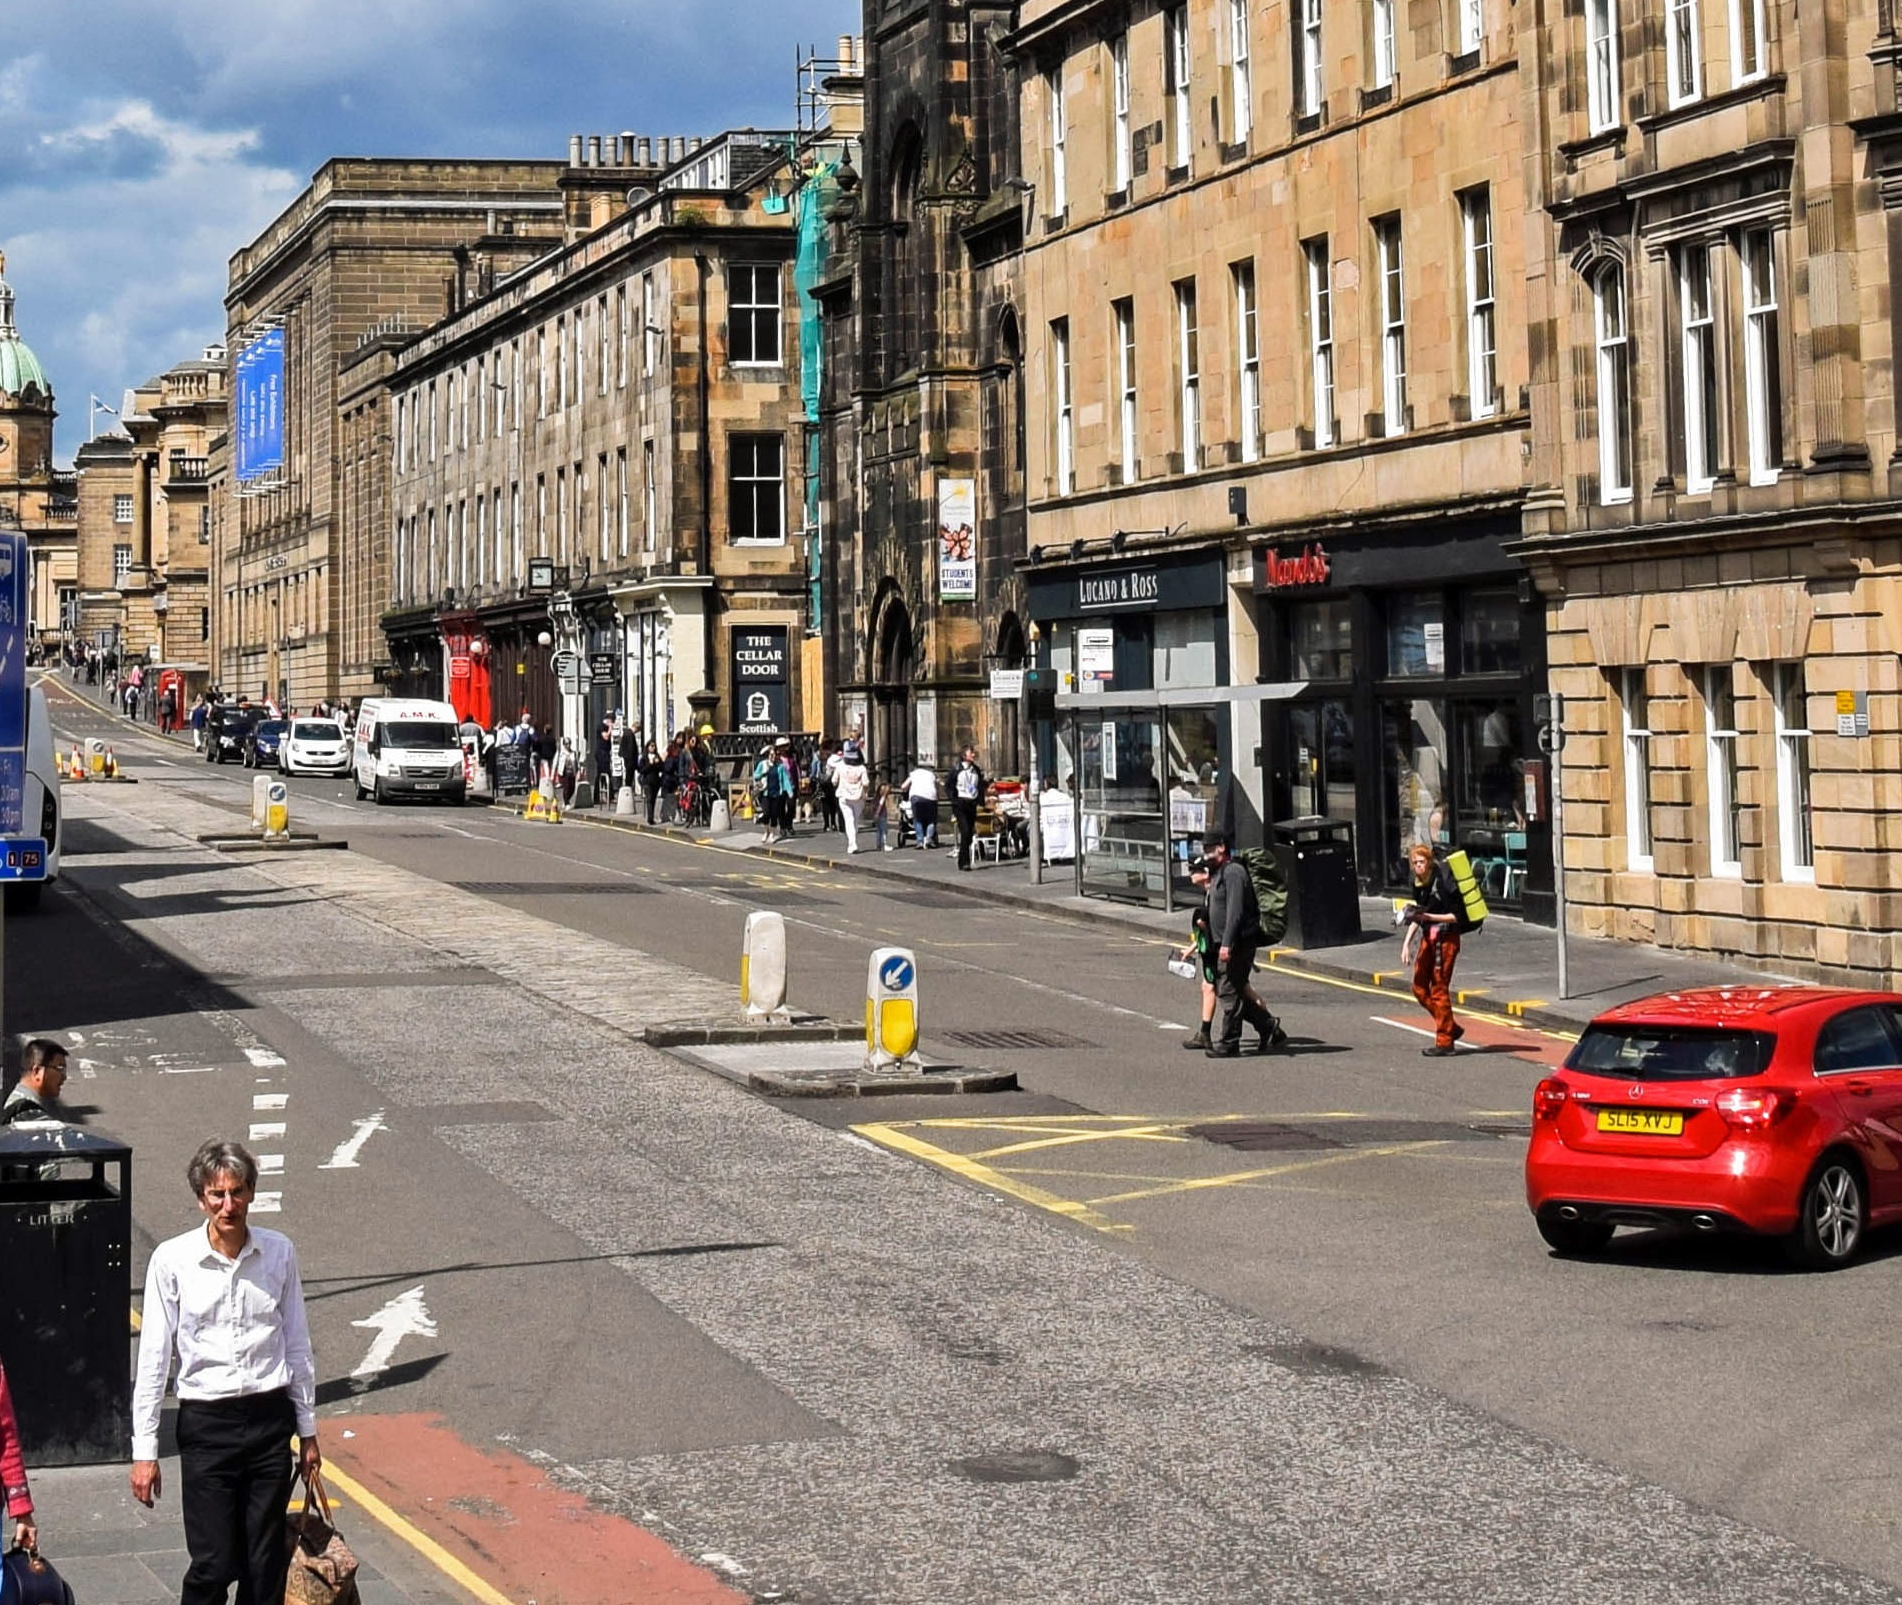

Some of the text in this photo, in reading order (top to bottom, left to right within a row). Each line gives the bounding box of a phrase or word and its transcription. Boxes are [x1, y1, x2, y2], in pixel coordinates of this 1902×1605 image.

[942, 568, 974, 578] STUDENTS
[942, 579, 973, 589] WELCOME
[1120, 578, 1128, 599] &
[746, 635, 772, 647] THE
[736, 649, 783, 661] CELLAR
[741, 664, 779, 676] DOOR
[738, 723, 778, 733] Scottish
[9, 854, 38, 865] 1 75
[1607, 1112, 1673, 1130] SL15 XVJ
[29, 1213, 75, 1226] LITTER
